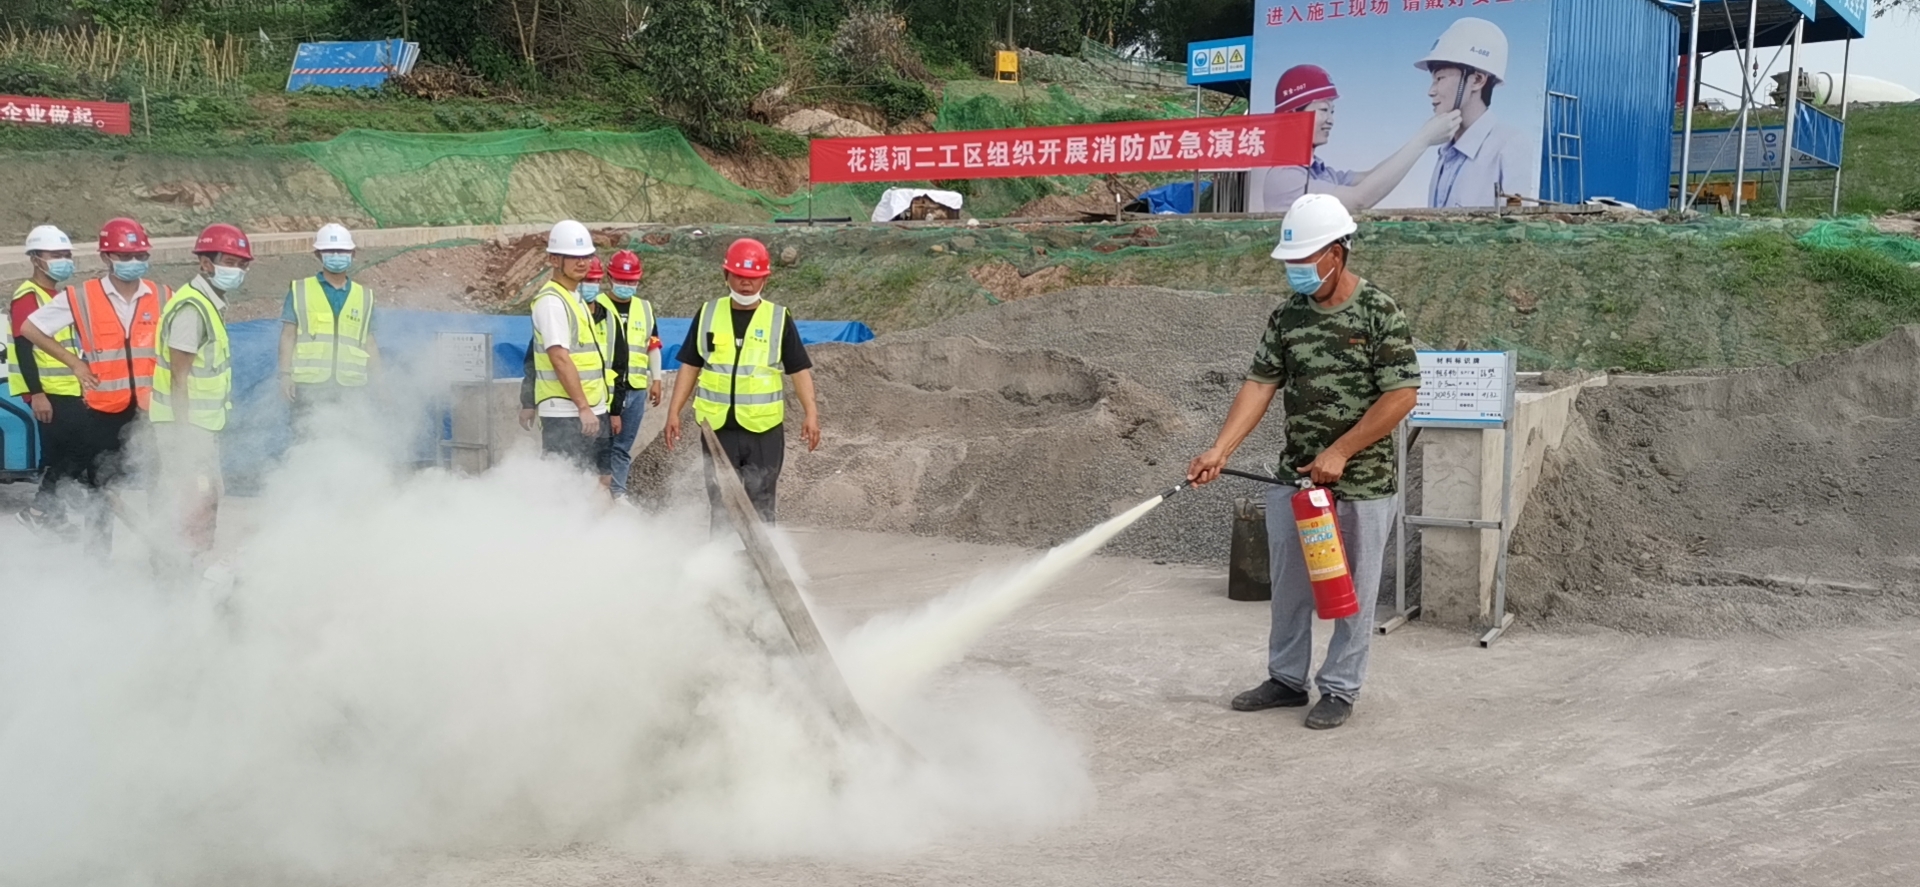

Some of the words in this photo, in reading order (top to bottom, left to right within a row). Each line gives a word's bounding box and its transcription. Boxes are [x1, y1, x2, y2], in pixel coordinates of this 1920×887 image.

[1266, 0, 1389, 26] 进入施工现场
[847, 127, 1266, 173] 花溪河二工区组织开展消防应急演练
